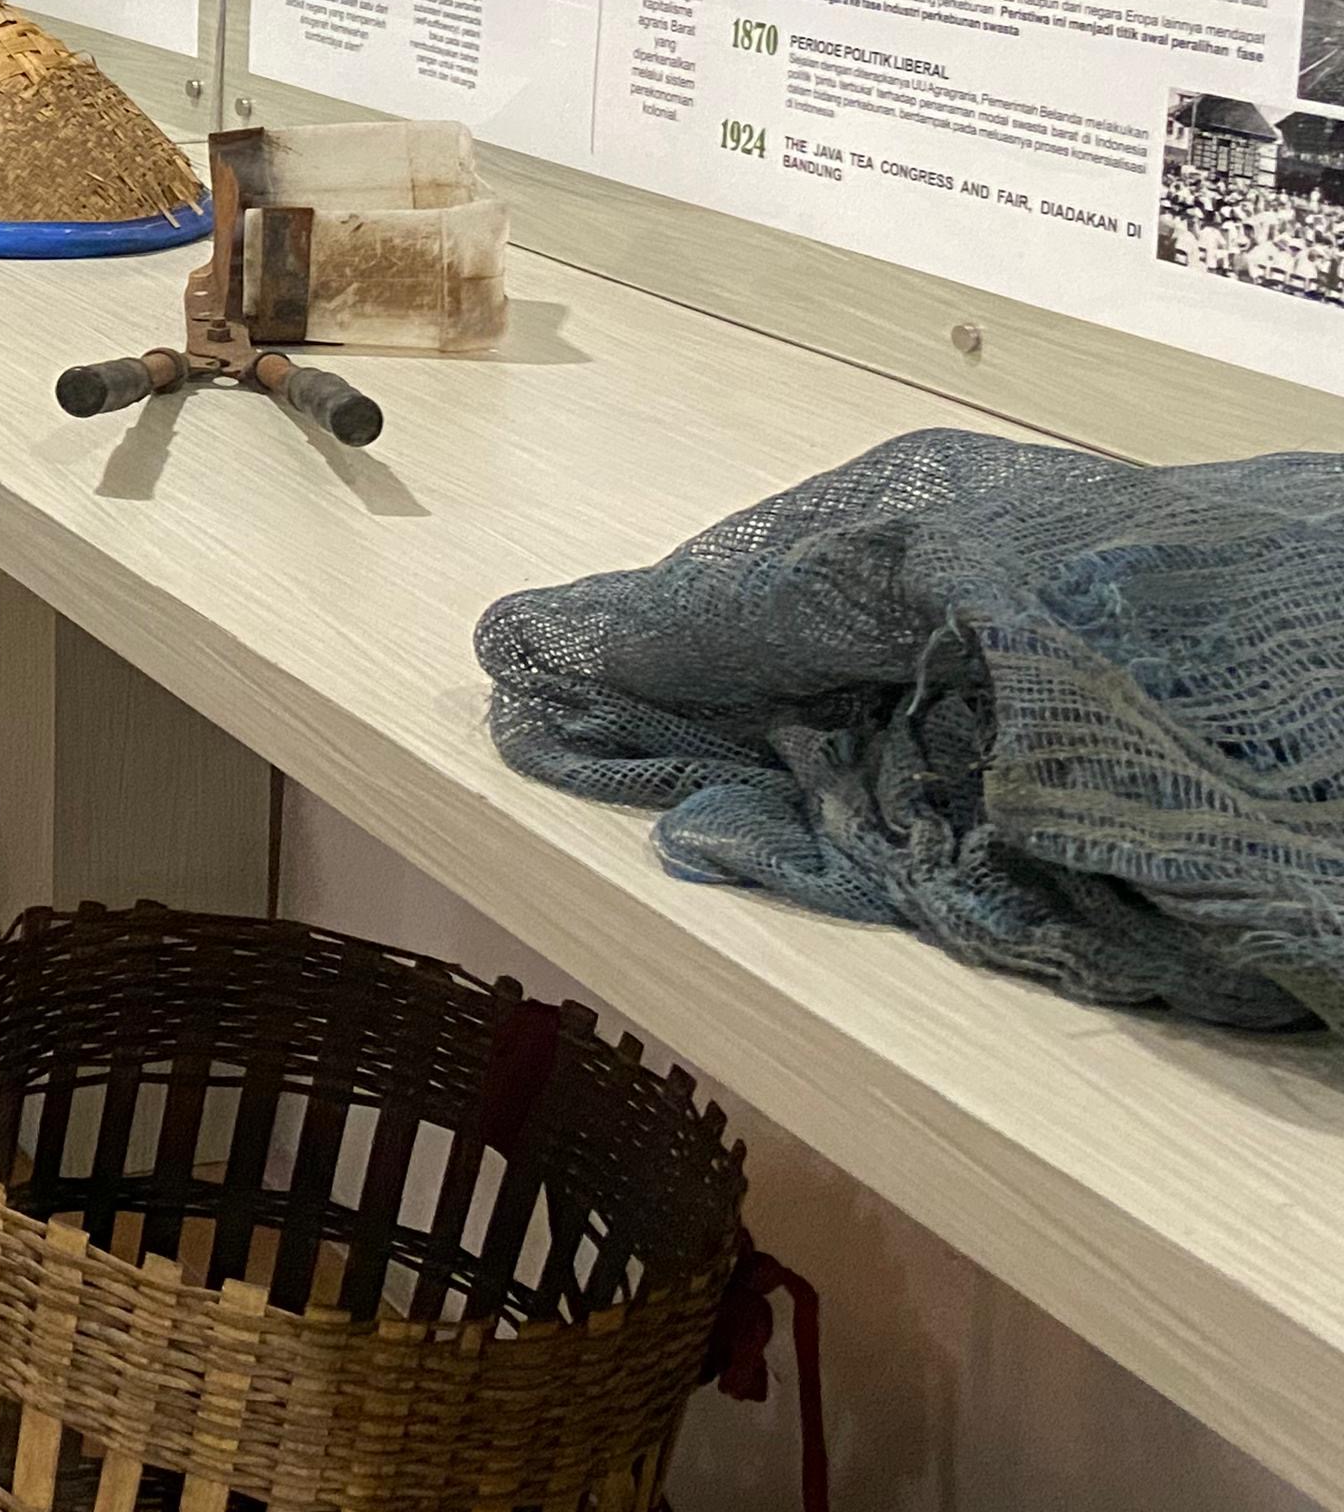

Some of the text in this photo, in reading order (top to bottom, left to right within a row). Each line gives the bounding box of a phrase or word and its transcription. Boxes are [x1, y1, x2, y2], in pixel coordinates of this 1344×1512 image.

[671, 20, 696, 36] Barat
[1000, 5, 1264, 61] Peristiwa ini menjadi titik awal peralihan fase
[1085, 6, 1121, 19] negara
[1125, 10, 1158, 27] Eropa
[1161, 16, 1202, 35] lainnya
[1205, 26, 1264, 44] mendapat
[732, 17, 949, 78] 1870 PERIODE POLITIK LIBERAL
[1040, 106, 1083, 125] Belanda
[1085, 118, 1148, 139] melakukan
[1034, 140, 1068, 155] proses
[1082, 132, 1090, 144] di
[1094, 135, 1146, 156] Indonesia
[721, 118, 1142, 237] 1924 THE JAVA TEA CONGRESS AND FAIR, DIADAKAN DI
[782, 154, 842, 180] BANDUNG
